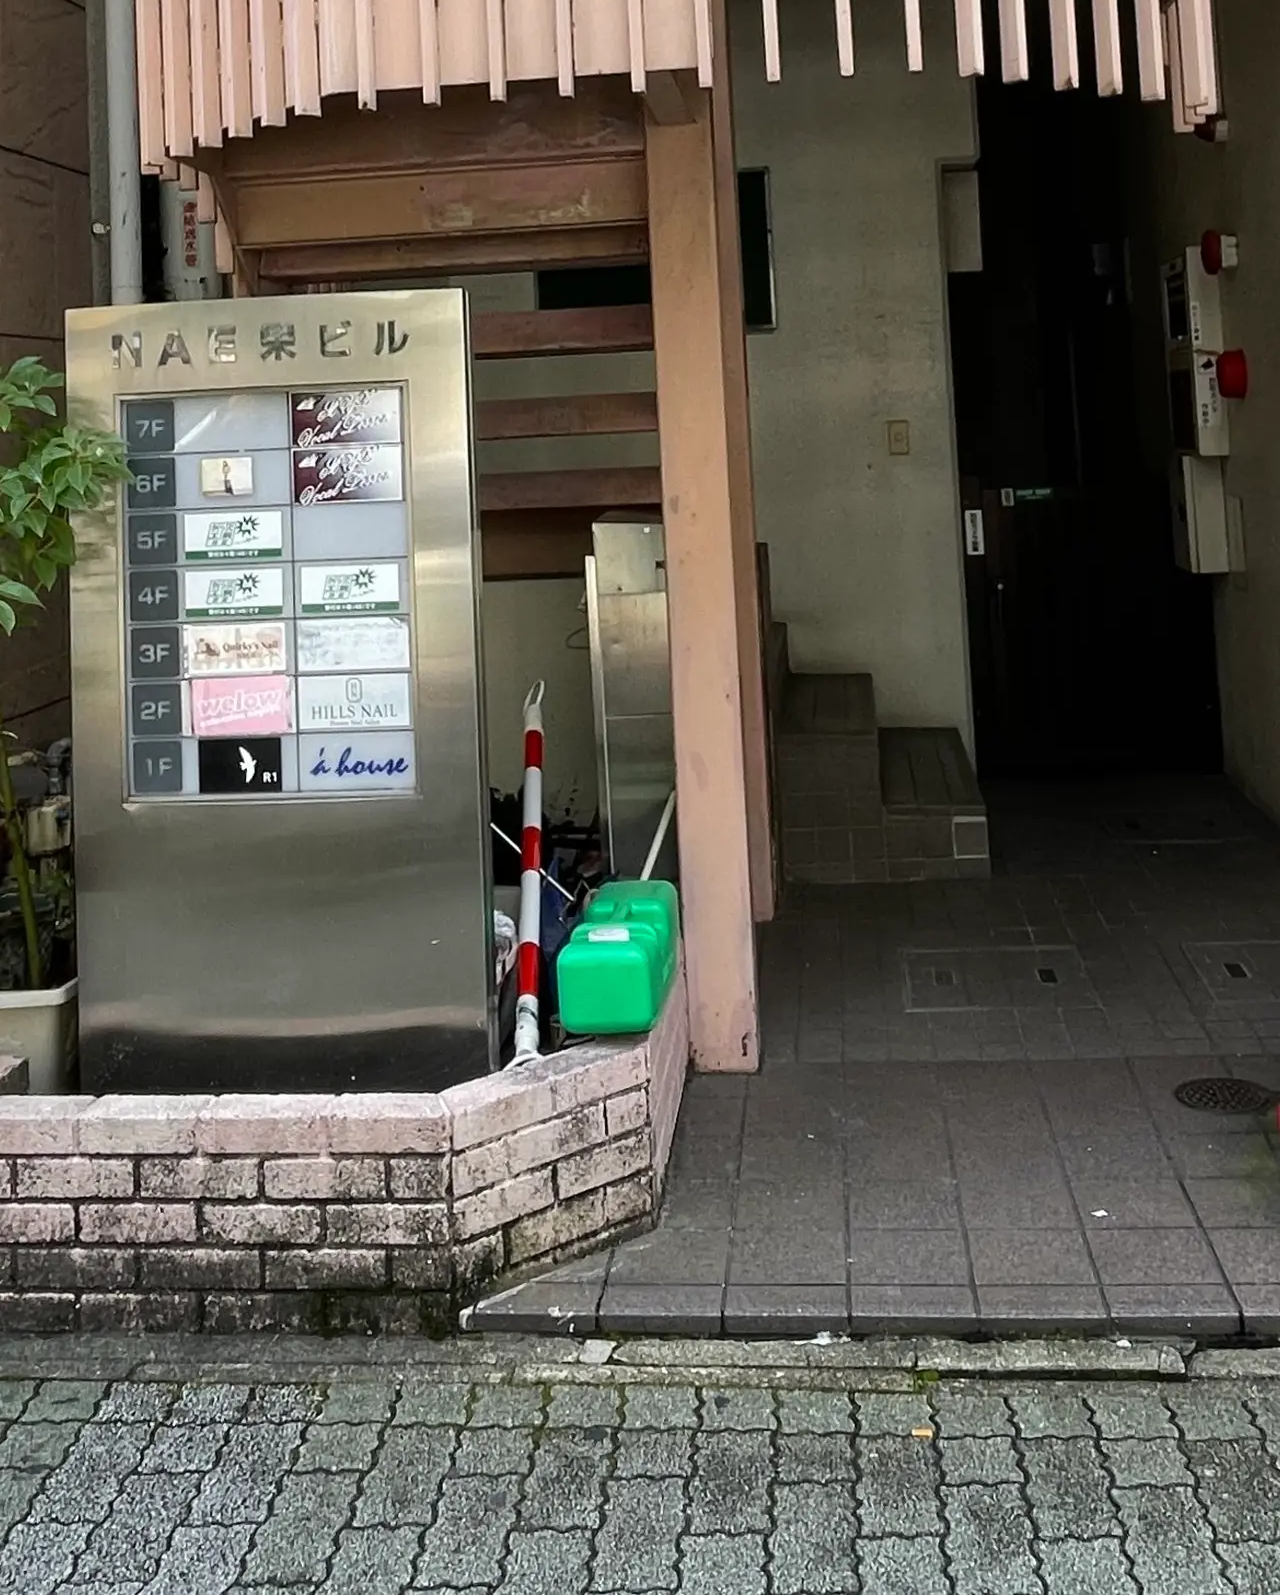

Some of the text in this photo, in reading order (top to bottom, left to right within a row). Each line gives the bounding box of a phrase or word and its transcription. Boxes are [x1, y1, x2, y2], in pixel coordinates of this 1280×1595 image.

[111, 318, 410, 370] NAE栄ビル
[135, 419, 166, 438] 7F
[135, 473, 167, 493] 6F
[136, 530, 168, 550] 5F
[137, 584, 169, 605] 4F
[138, 643, 170, 663] 3F
[140, 701, 172, 721] 2F
[198, 689, 283, 717] welow
[312, 703, 398, 720] HILLS NAIL
[144, 757, 173, 778] 1F
[335, 746, 409, 777] house
